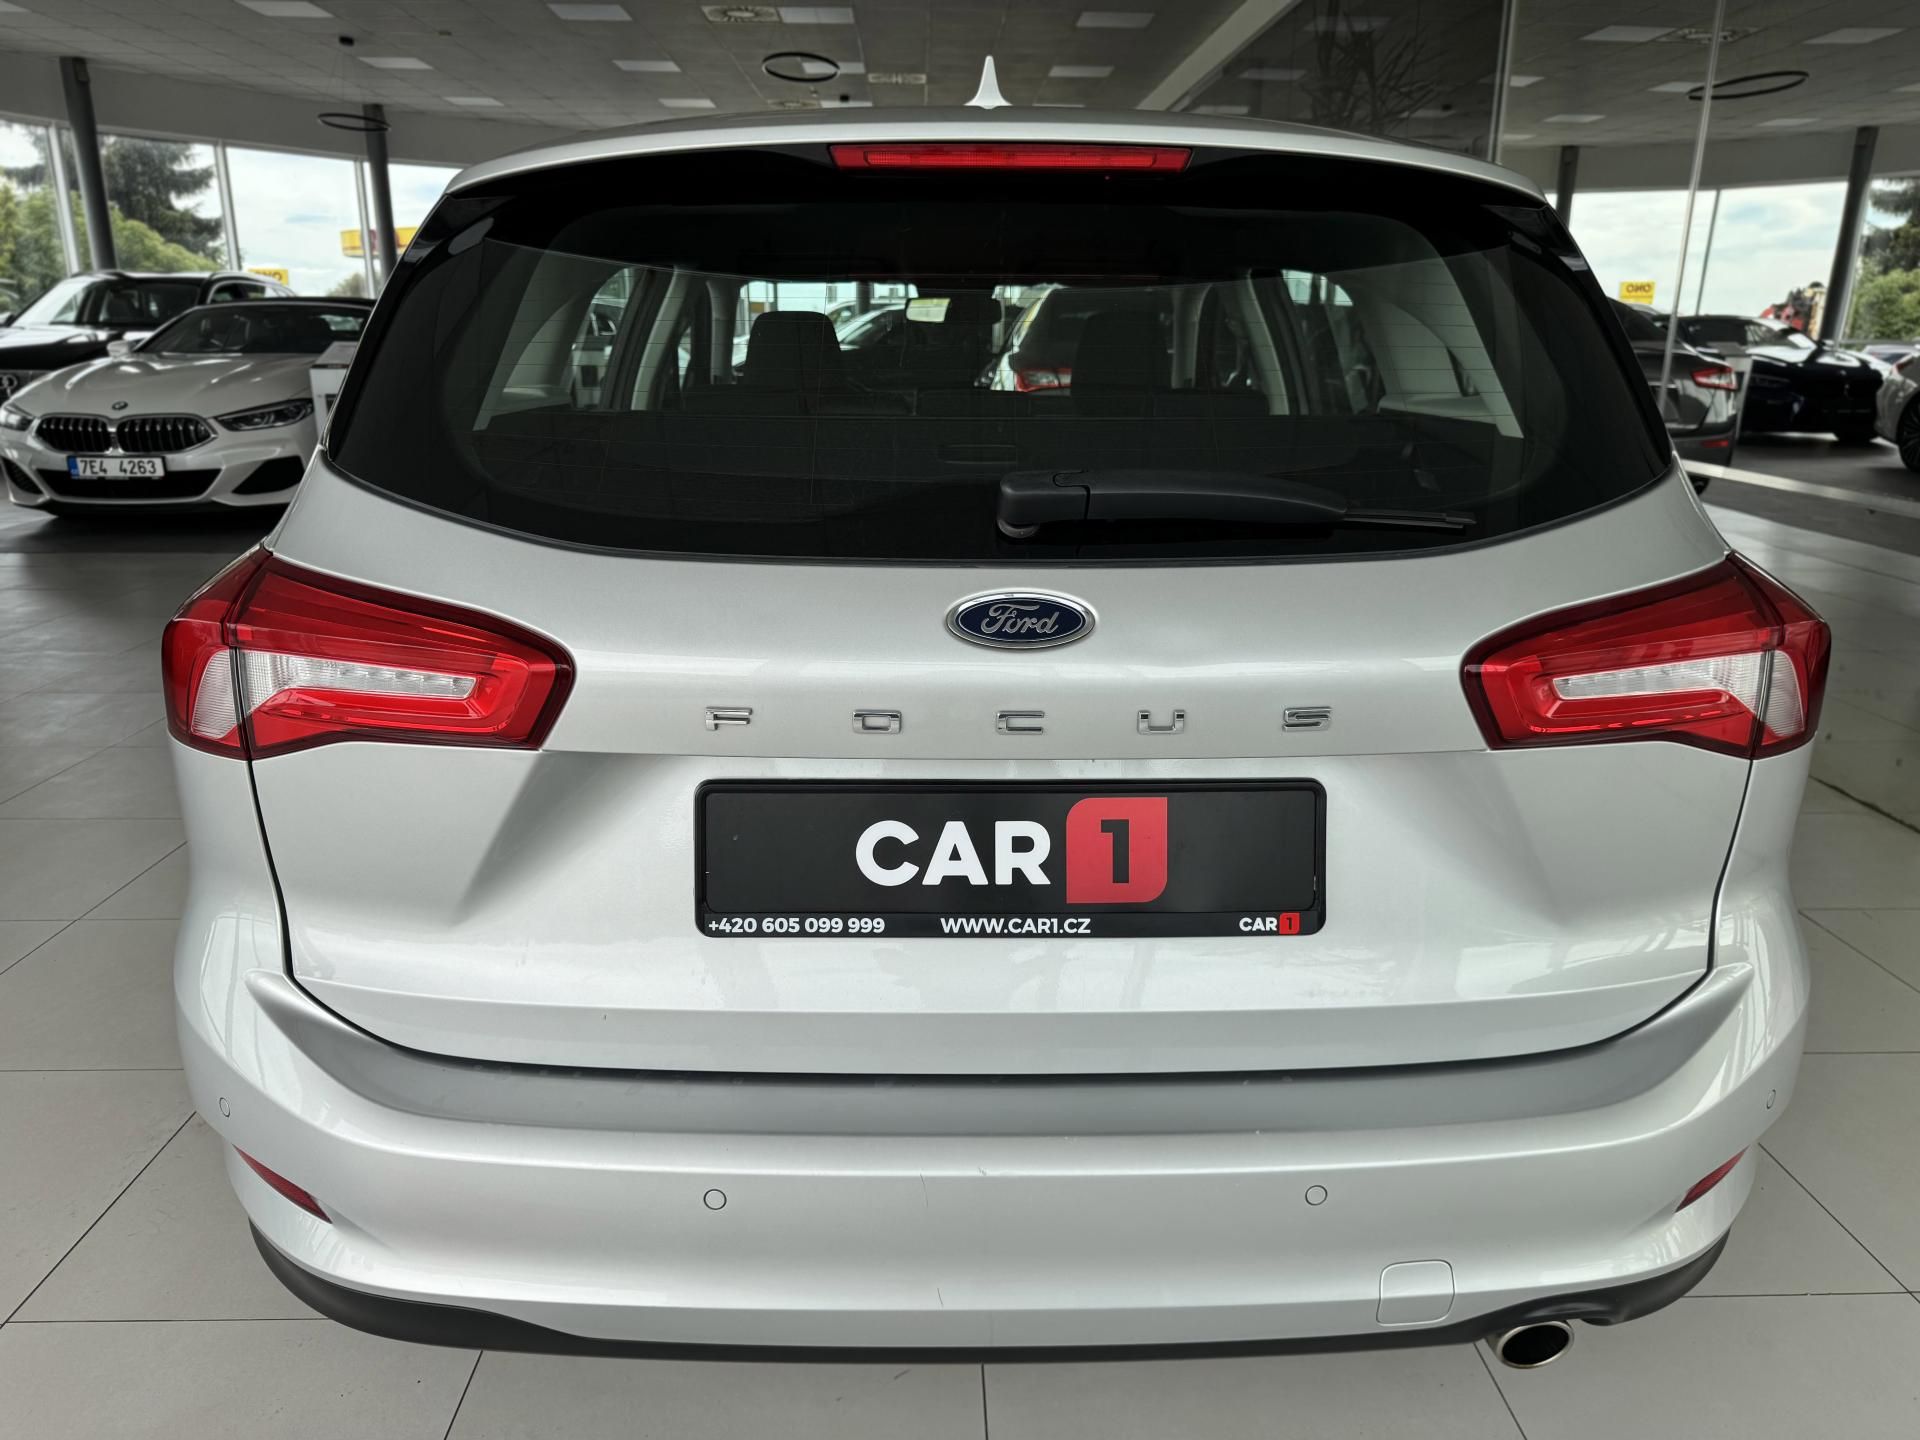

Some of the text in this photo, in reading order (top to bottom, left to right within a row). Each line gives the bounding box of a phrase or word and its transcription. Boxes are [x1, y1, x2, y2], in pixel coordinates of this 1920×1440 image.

[80, 460, 107, 474] 7E4
[119, 460, 157, 474] 4263
[980, 603, 1060, 634] Ford
[705, 706, 1332, 734] FOCUS
[855, 818, 1130, 887] CAR 1
[708, 917, 885, 933] +420 605 099 999
[940, 917, 1091, 934] WWW.CAR1.CZ
[1239, 917, 1278, 932] CAR
